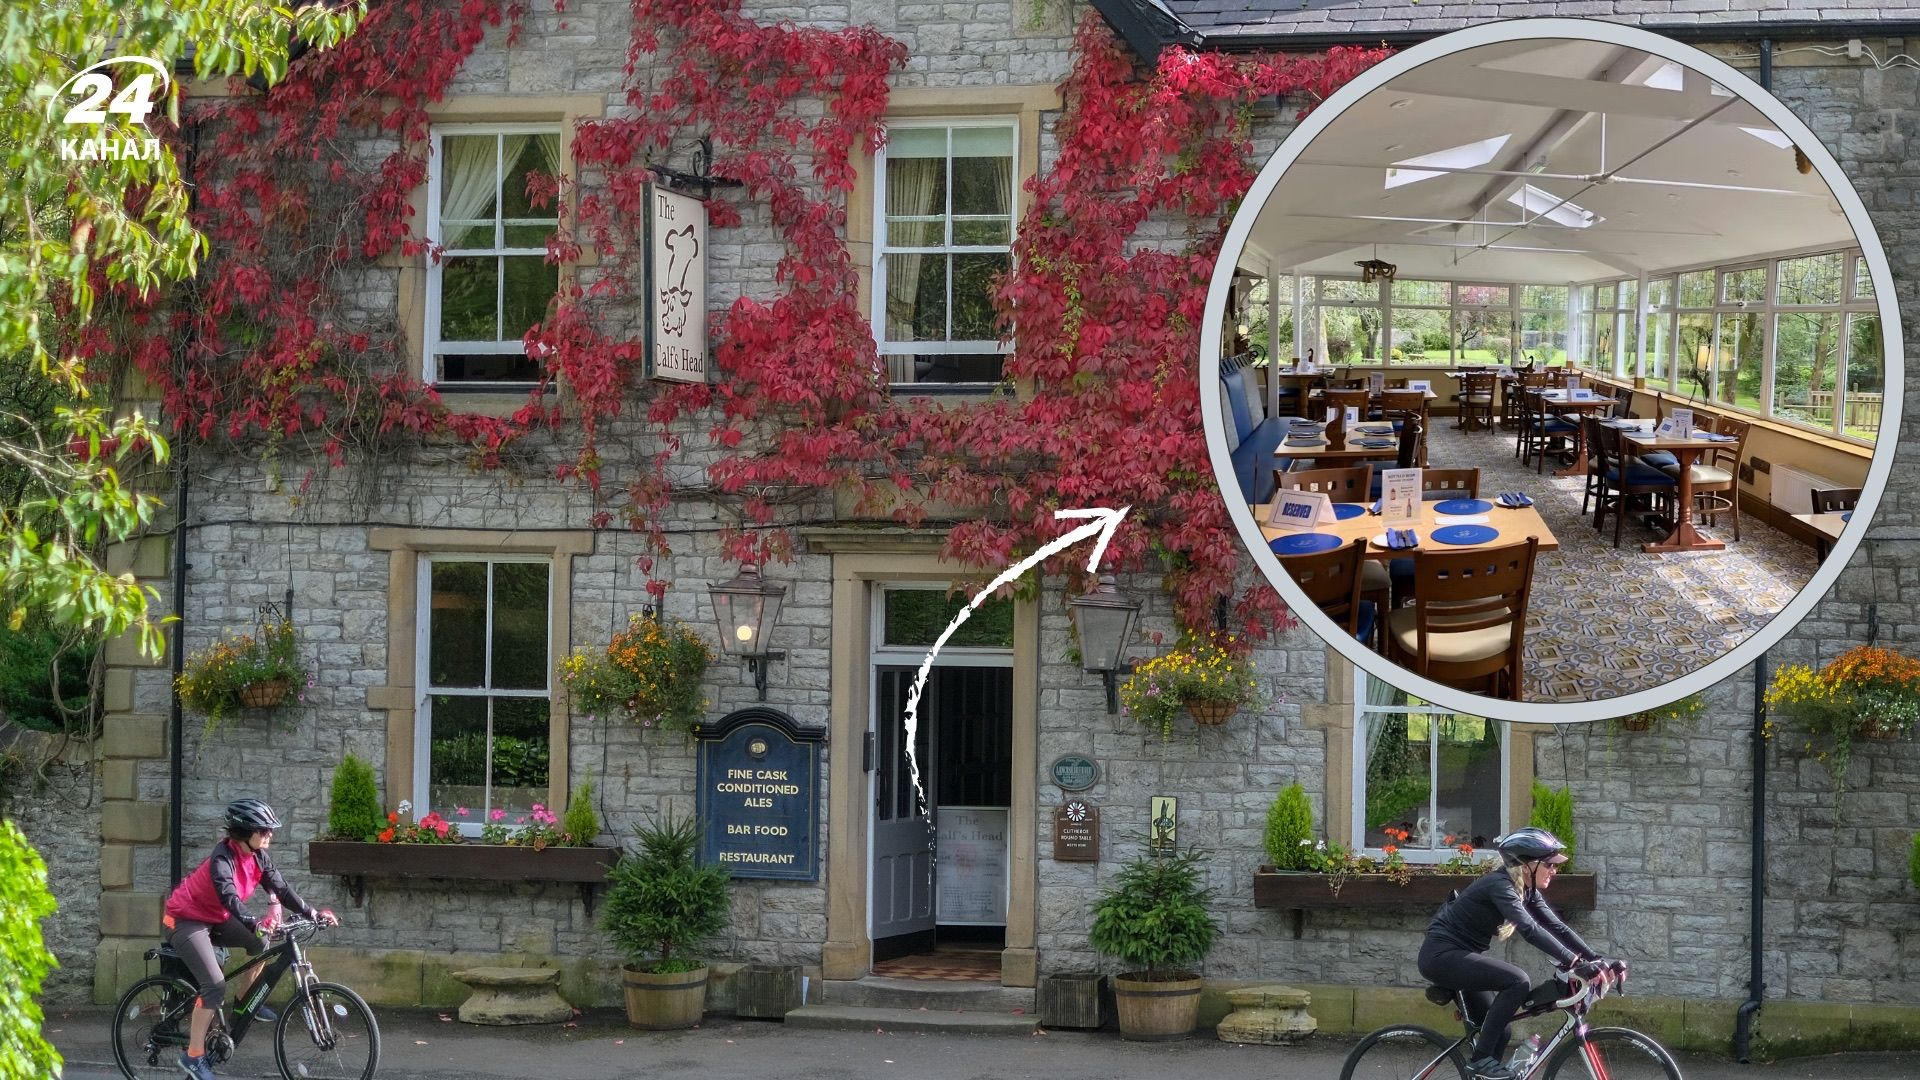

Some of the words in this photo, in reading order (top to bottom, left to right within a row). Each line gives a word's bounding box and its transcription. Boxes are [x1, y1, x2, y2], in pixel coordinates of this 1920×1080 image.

[658, 194, 675, 220] The
[681, 348, 703, 373] Head
[727, 769, 753, 779] FINE
[756, 770, 788, 781] CASK
[717, 783, 799, 795] CONDITIONED
[744, 798, 773, 808] ALES
[727, 824, 751, 834] BAR
[754, 825, 788, 836] FOOD
[971, 831, 1003, 841] Head
[719, 852, 795, 864] RESTAURANT
